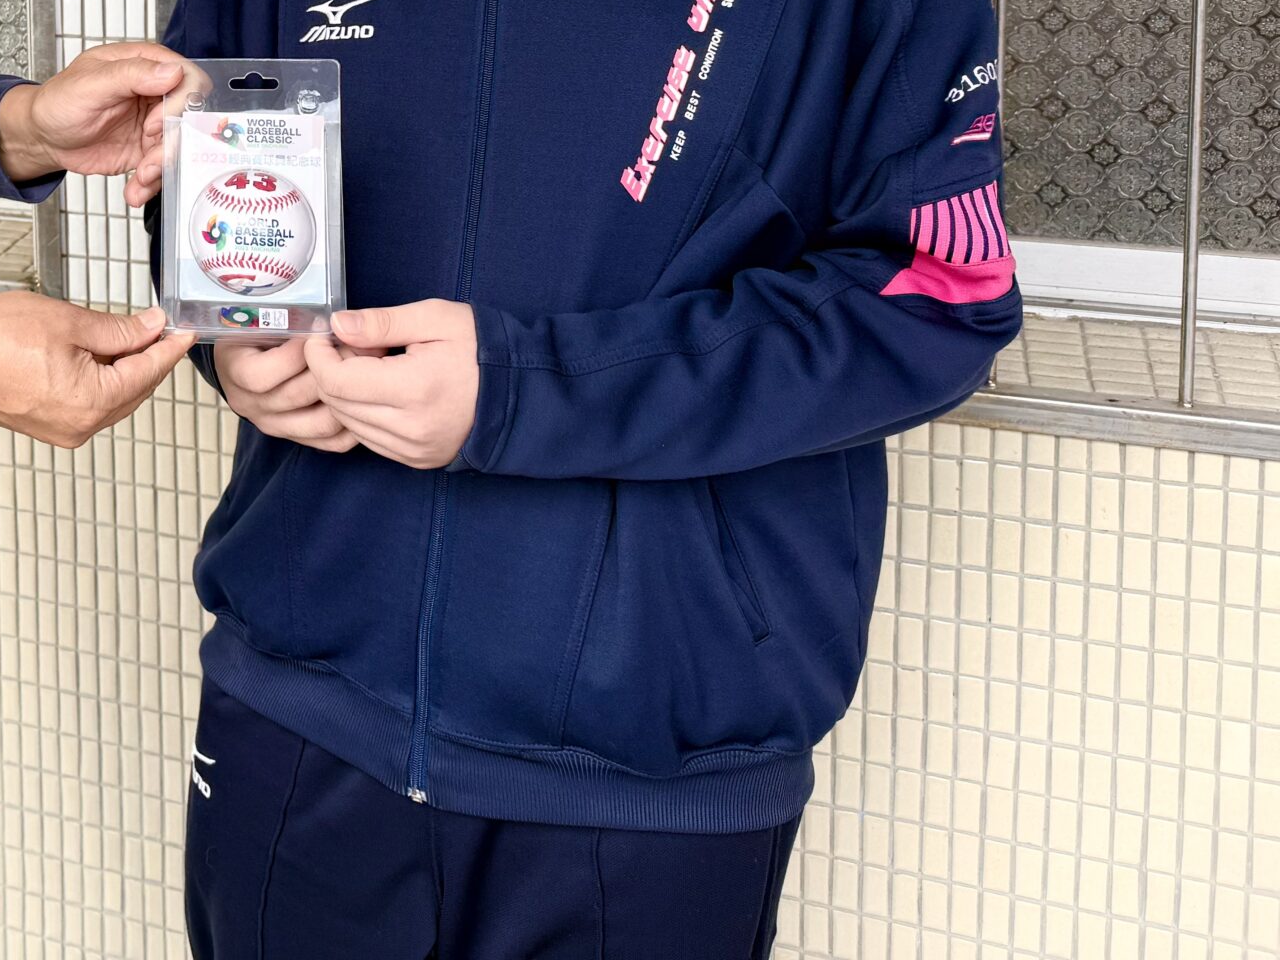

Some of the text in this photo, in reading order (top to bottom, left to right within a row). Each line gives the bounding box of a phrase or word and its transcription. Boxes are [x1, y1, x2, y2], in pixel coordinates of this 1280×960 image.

[299, 25, 374, 43] MIZUNO
[944, 58, 998, 102] 3160
[670, 130, 687, 161] KEEP
[684, 90, 702, 121] BEST
[698, 28, 724, 80] CONDITION
[246, 118, 287, 128] WORLD
[620, 45, 697, 203] Exercise
[246, 127, 302, 137] BASEBALL
[246, 135, 293, 145] CLASSIC
[224, 171, 278, 192] 43
[235, 227, 295, 239] BASEBALL
[234, 236, 286, 248] CLASSIC
